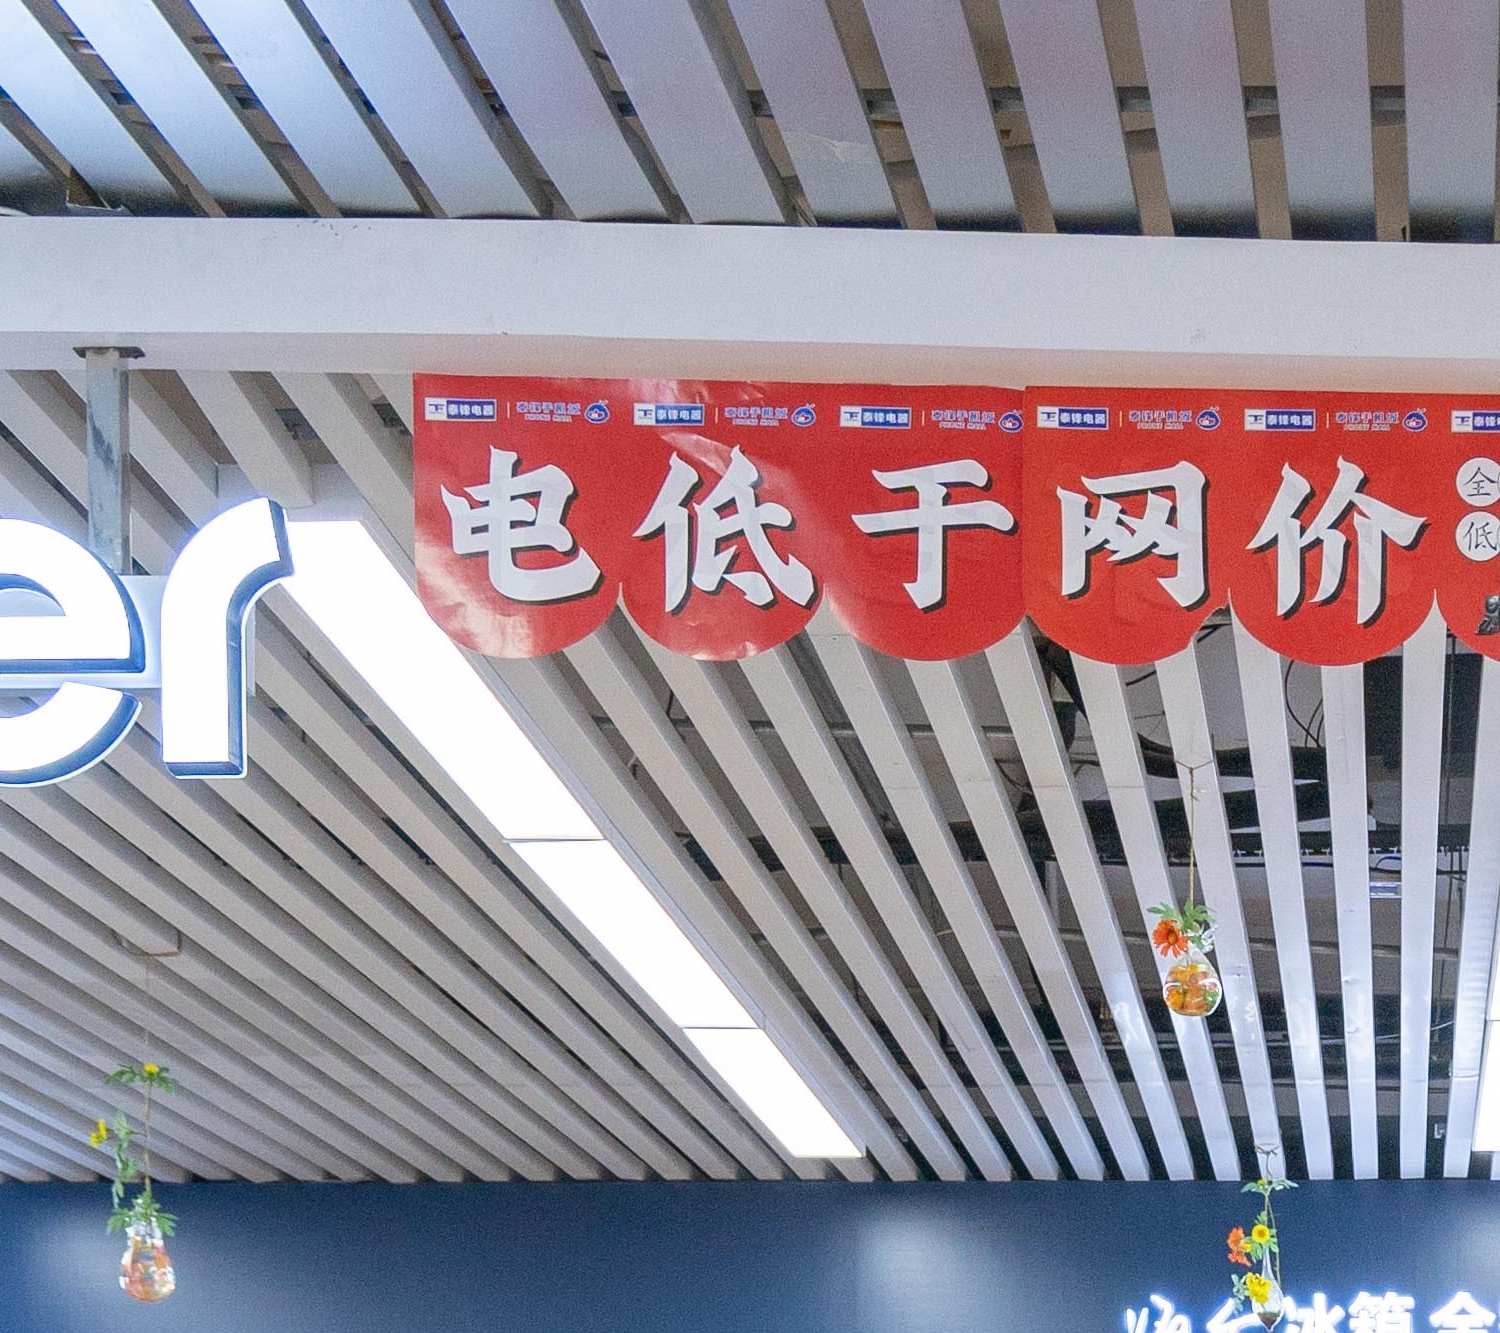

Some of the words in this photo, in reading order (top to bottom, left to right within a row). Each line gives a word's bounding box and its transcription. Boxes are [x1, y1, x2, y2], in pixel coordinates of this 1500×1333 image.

[446, 402, 494, 418] 泰锋电器
[655, 406, 703, 422] 泰锋电器
[862, 410, 910, 424] 泰锋电器
[1059, 411, 1107, 426] 泰锋电器
[1267, 412, 1315, 428] 泰锋电器
